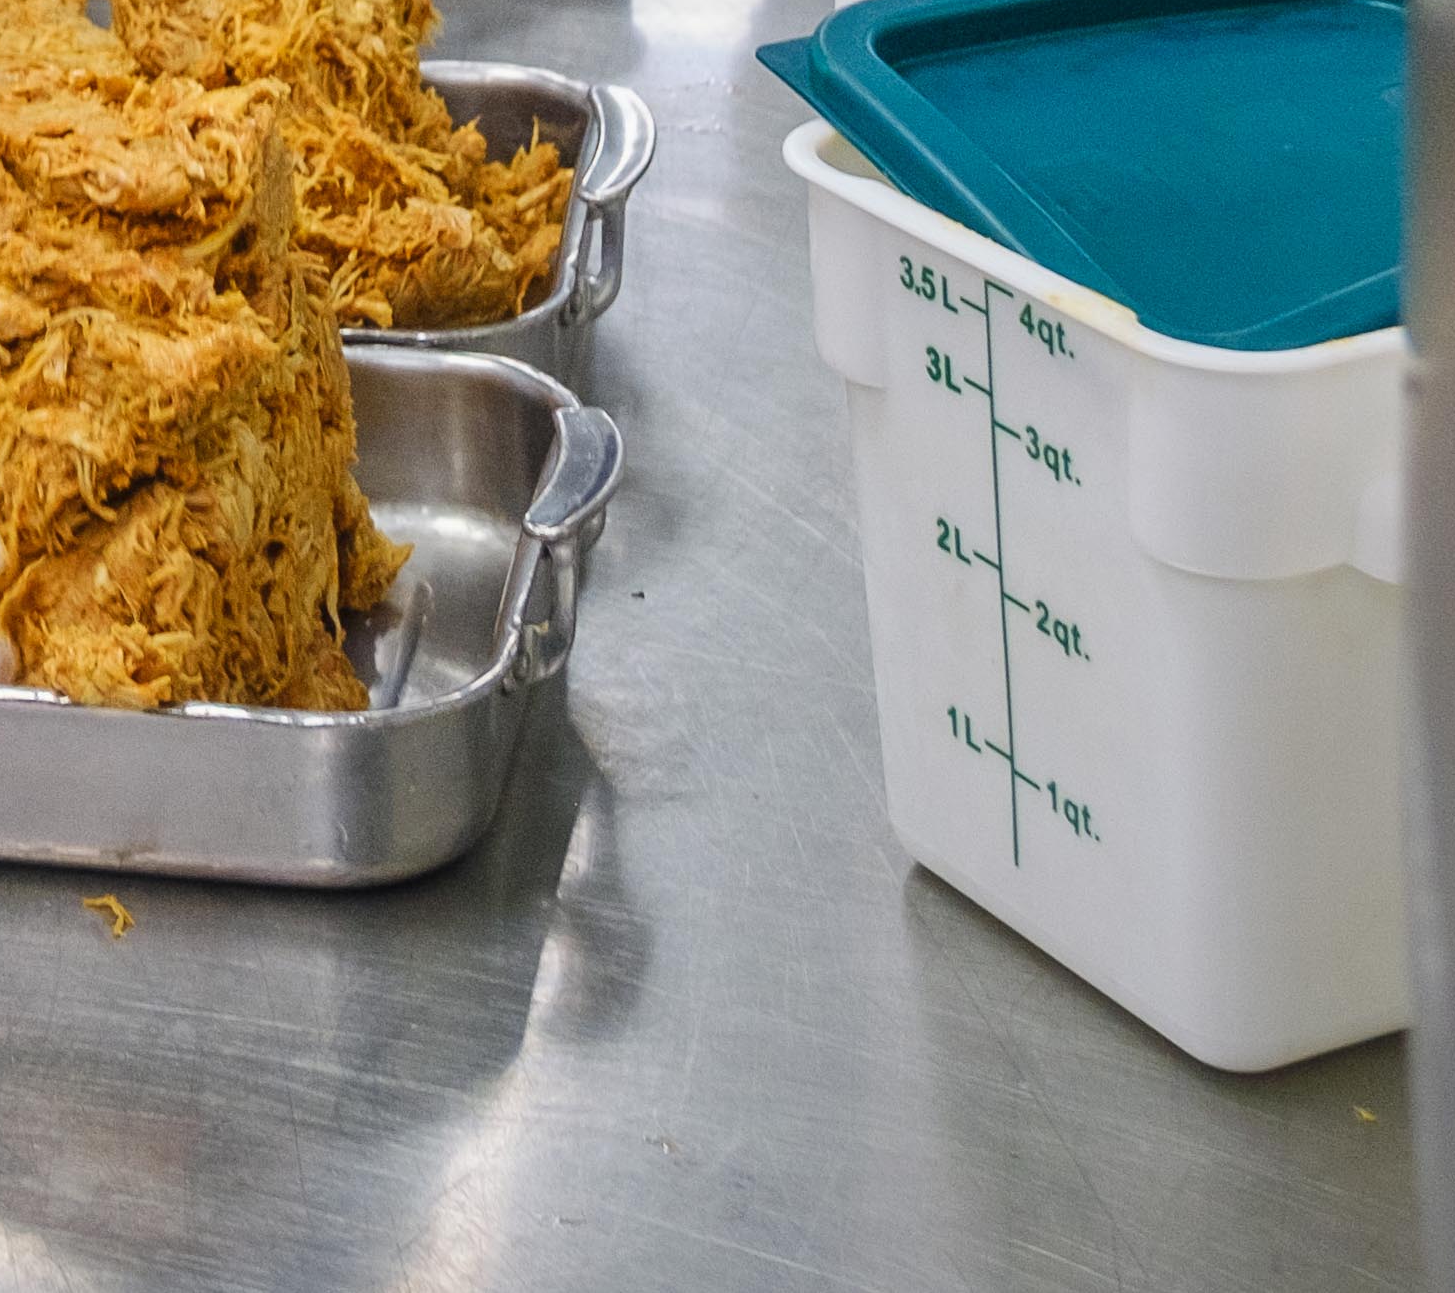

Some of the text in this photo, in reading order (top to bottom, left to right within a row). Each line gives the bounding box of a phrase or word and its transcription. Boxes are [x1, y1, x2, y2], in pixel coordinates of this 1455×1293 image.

[1018, 303, 1075, 359] 4qt.
[925, 345, 962, 395] 3L
[1024, 425, 1082, 487] 3qt.
[936, 516, 972, 566] 2L
[1034, 599, 1090, 662] 2qt.
